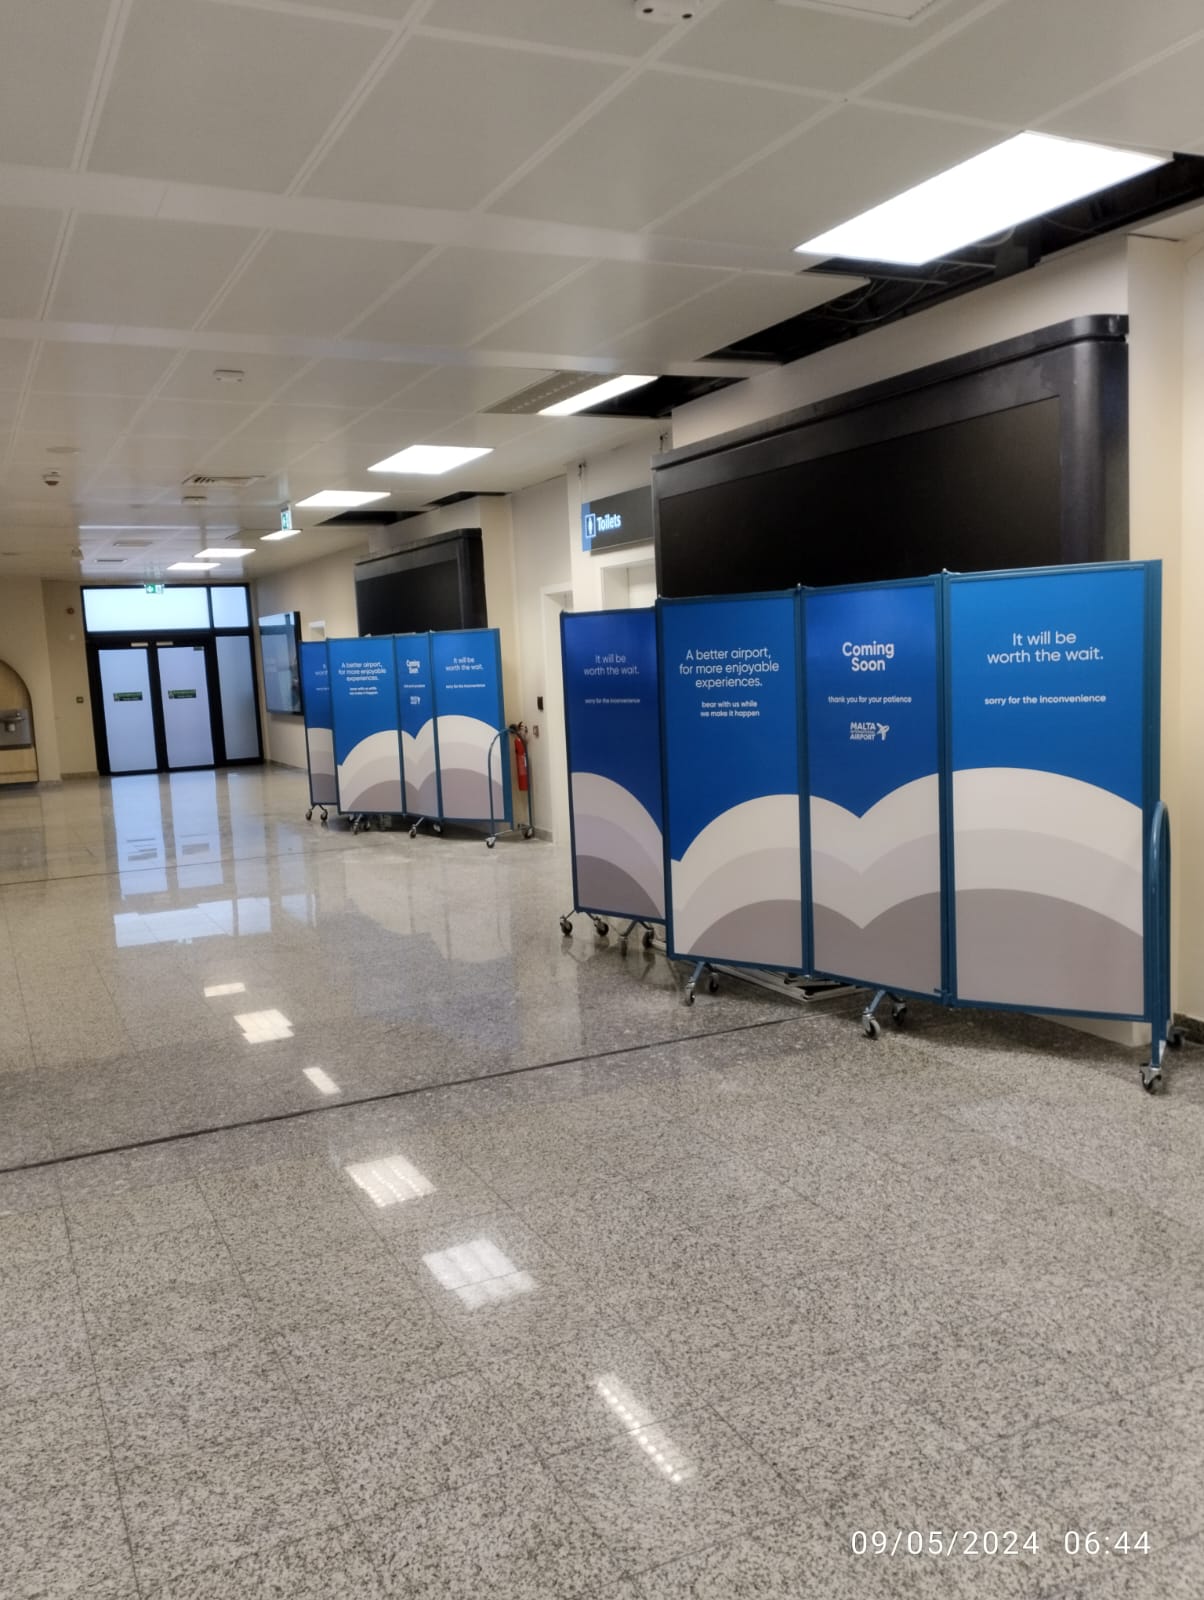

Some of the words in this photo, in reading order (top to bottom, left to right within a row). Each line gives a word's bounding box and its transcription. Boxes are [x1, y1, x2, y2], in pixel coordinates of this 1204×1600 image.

[597, 513, 622, 531] Toilets
[1012, 632, 1023, 646] It
[1027, 630, 1051, 645] will
[1055, 630, 1077, 644] be
[686, 649, 694, 660] A
[696, 648, 728, 660] better
[730, 647, 771, 661] airport,
[842, 640, 895, 659] Coming
[987, 649, 1031, 664] worth
[1034, 648, 1061, 662] the
[1065, 646, 1104, 661] wait.
[615, 654, 626, 663] be
[851, 656, 886, 671] Soon
[584, 667, 605, 675] worth
[606, 666, 619, 675] the
[679, 663, 693, 675] for
[695, 664, 723, 674] more
[725, 660, 780, 676] enjoyable
[695, 676, 763, 690] experiences.
[828, 696, 845, 704] thank
[846, 697, 858, 705] you
[858, 695, 868, 703] for
[868, 697, 882, 705] your
[882, 695, 912, 705] patience
[1008, 695, 1020, 705] for
[1022, 695, 1038, 704] the
[1039, 694, 1107, 704] inconvenience
[850, 721, 876, 730] MALTA
